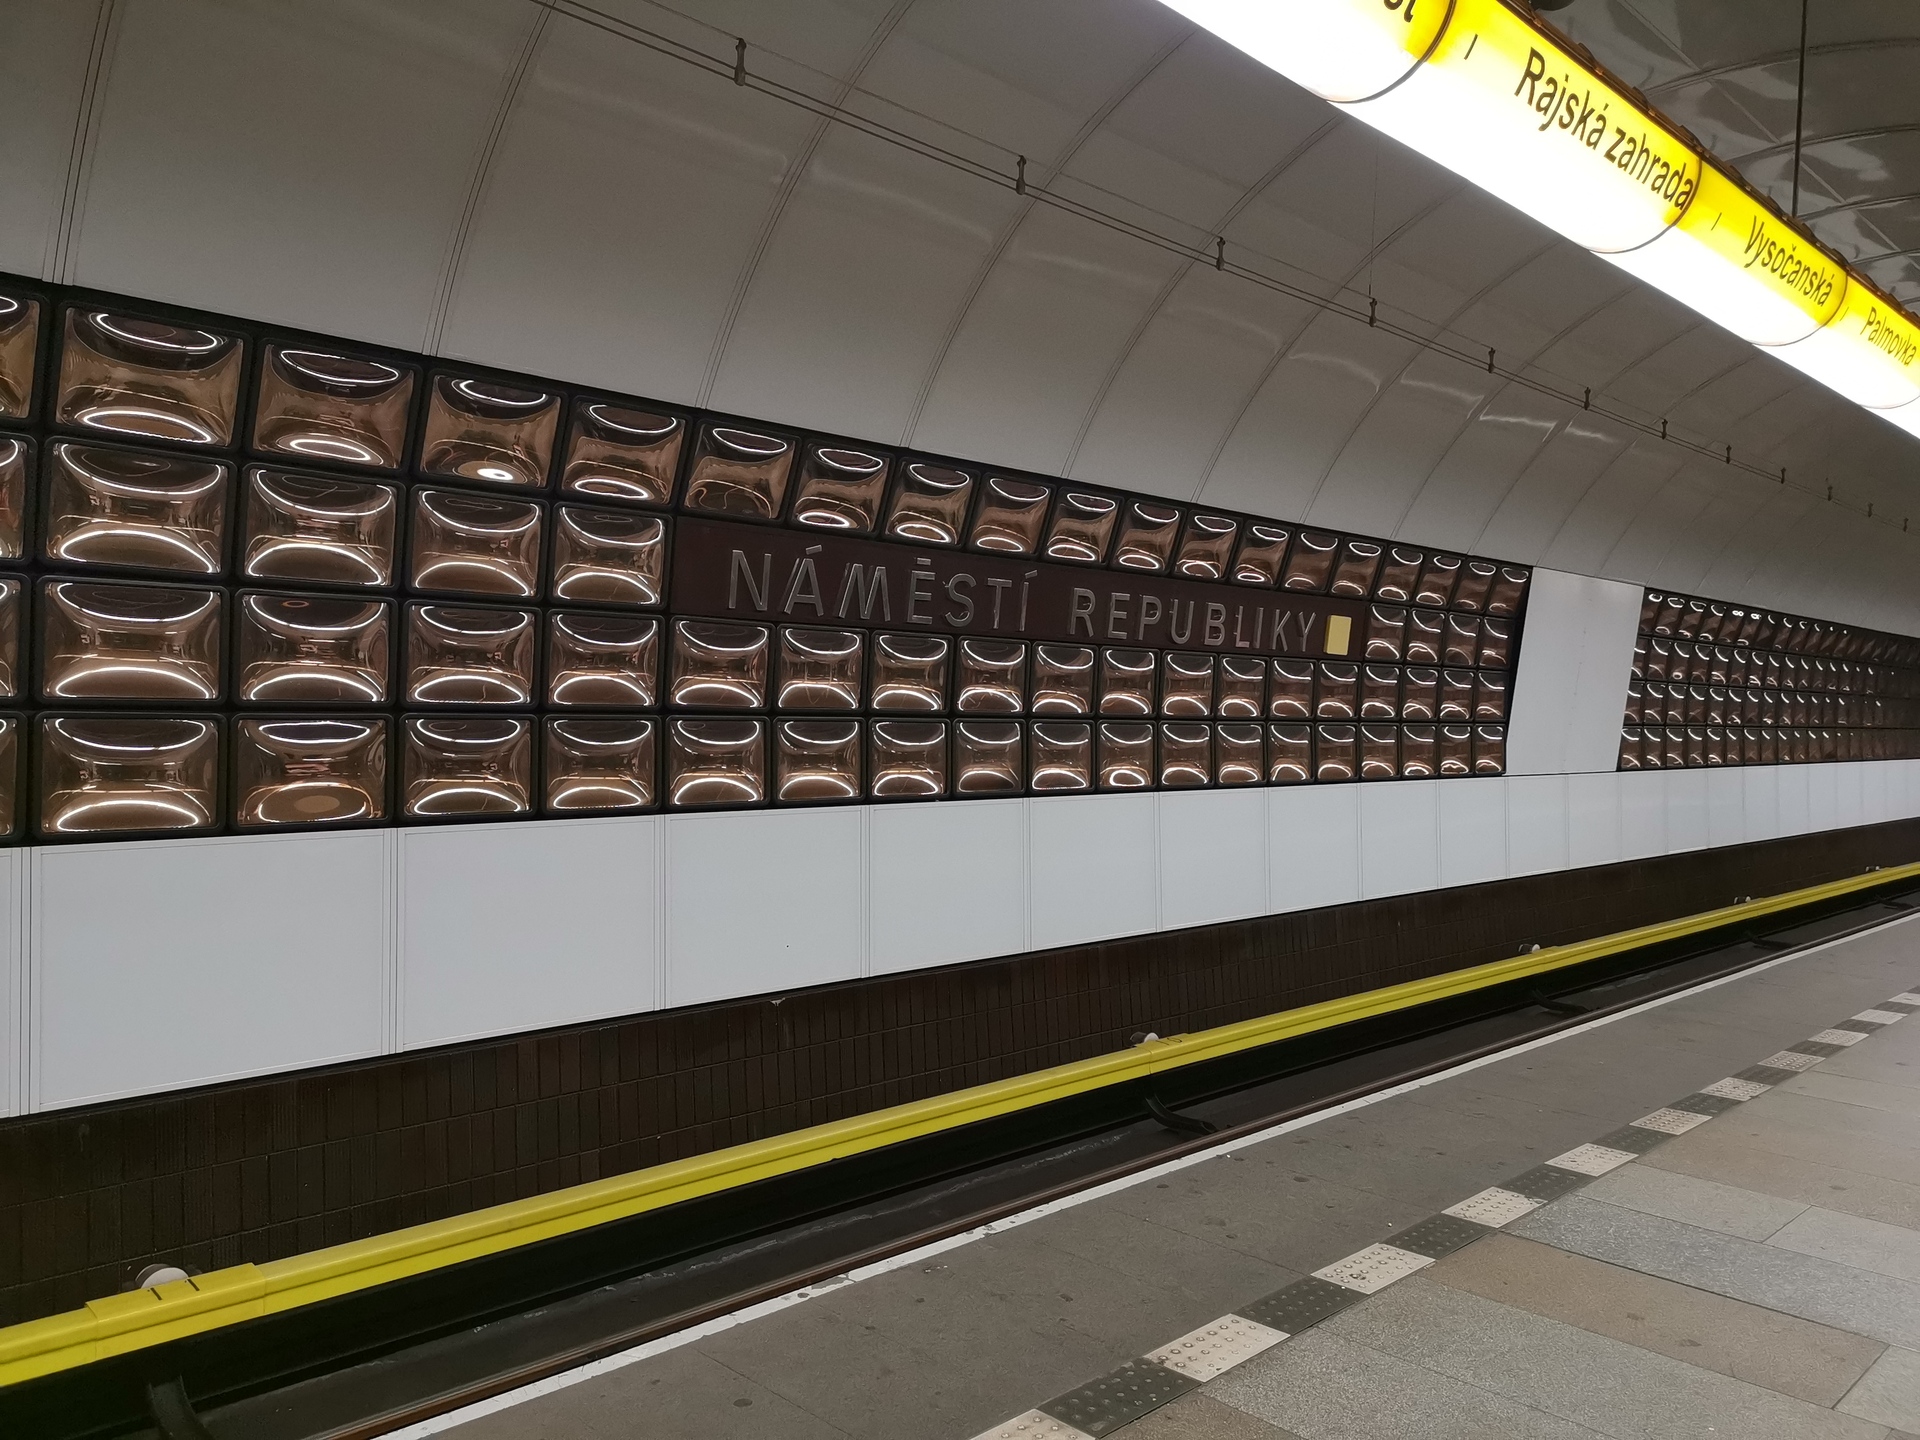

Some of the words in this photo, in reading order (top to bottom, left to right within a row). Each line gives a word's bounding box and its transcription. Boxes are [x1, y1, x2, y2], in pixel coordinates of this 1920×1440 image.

[1514, 46, 1609, 150] Rajská
[1604, 126, 1694, 211] zahrada
[1744, 215, 1834, 307] Vysočanská
[1860, 306, 1918, 367] Palmovka
[1068, 587, 1317, 652] REPUBLIKY
